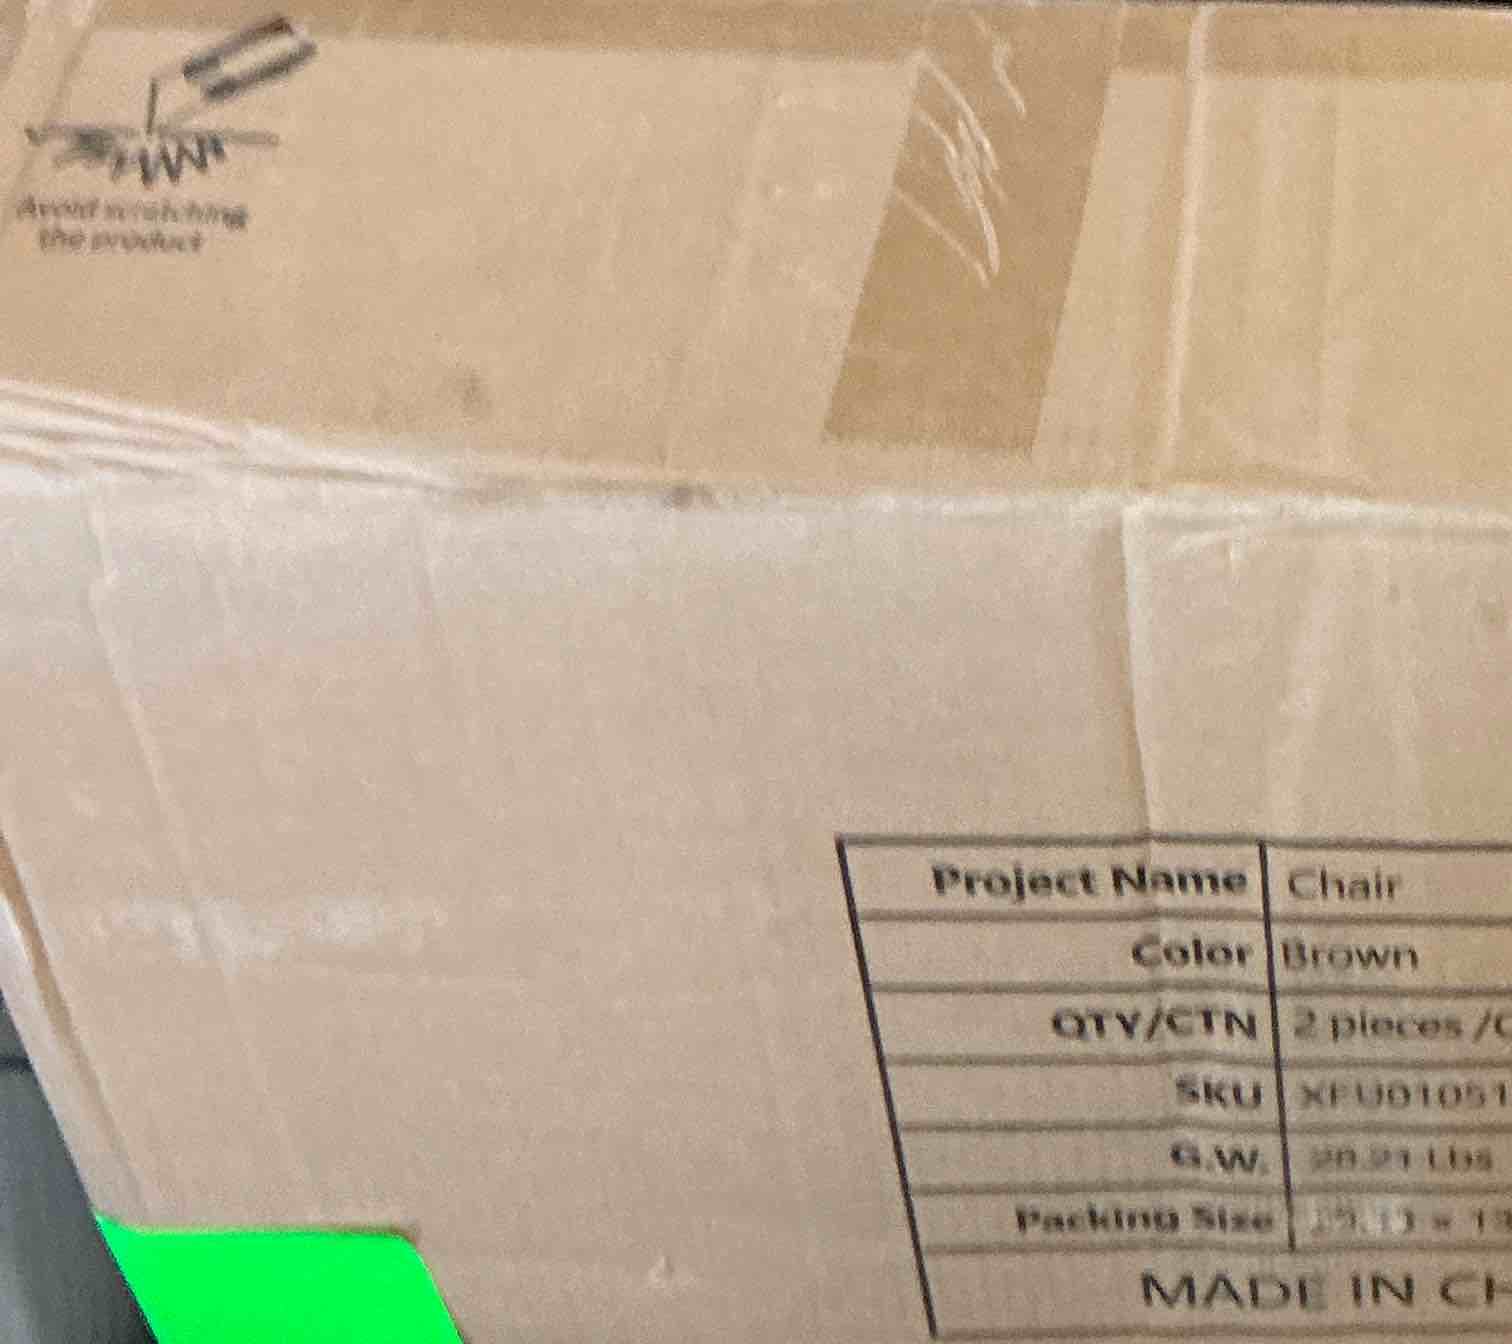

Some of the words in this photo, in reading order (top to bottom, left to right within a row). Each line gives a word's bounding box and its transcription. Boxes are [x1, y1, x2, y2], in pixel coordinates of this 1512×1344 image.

[930, 863, 1097, 904] Project
[1110, 863, 1249, 897] Name
[1287, 864, 1401, 901] Chair
[1130, 935, 1252, 969] Color
[1280, 940, 1420, 971] Brown
[1050, 1006, 1258, 1043] QTY/CTN
[1291, 1009, 1317, 1041] 2
[1330, 1009, 1464, 1043] pieces
[1175, 1072, 1265, 1112] SKU
[1014, 1203, 1180, 1236] Packing
[1191, 1204, 1275, 1234] Size
[1139, 1271, 1330, 1311] MADE
[1351, 1271, 1416, 1308] IN
